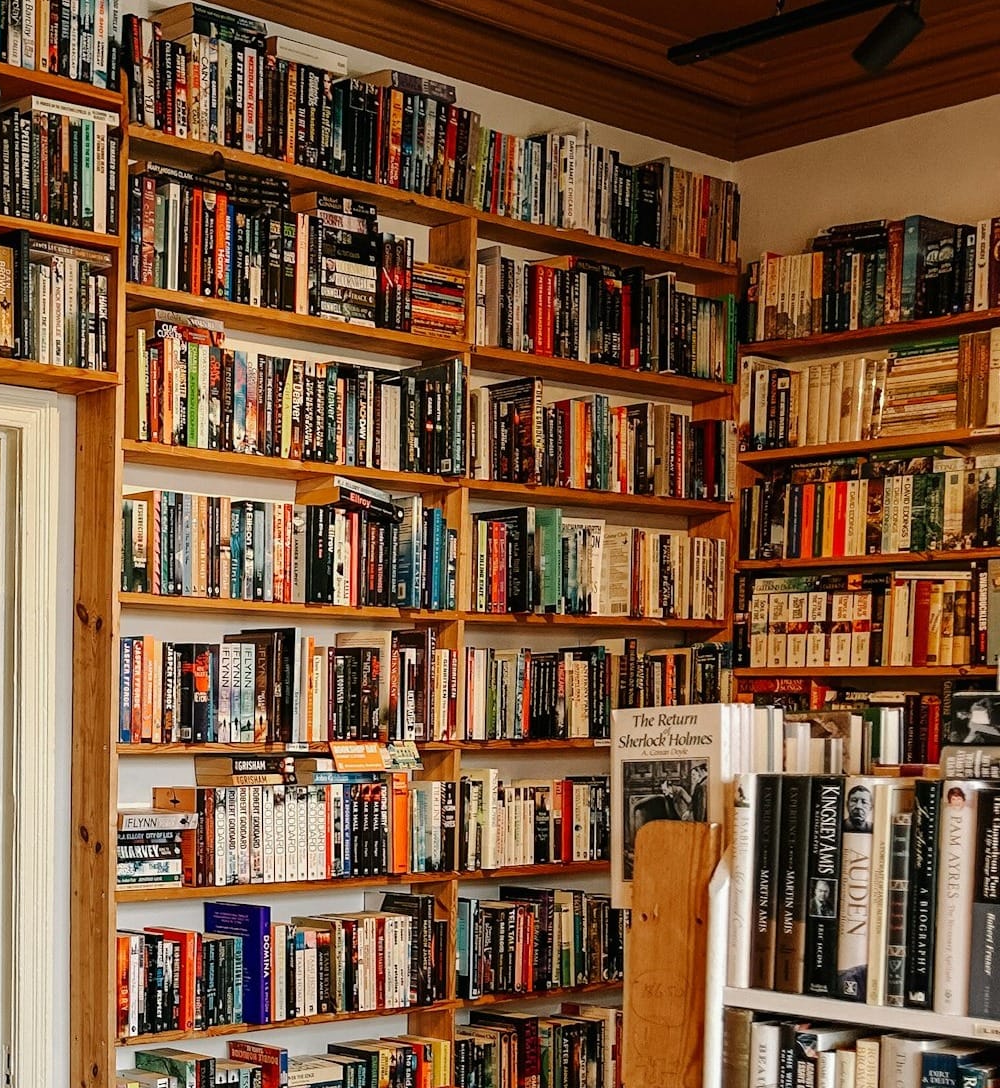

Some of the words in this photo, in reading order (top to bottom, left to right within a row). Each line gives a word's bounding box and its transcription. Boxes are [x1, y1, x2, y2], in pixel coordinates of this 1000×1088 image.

[246, 55, 255, 101] MEDDLING
[246, 102, 255, 125] KIDS
[567, 140, 575, 161] DAVID
[567, 161, 575, 186] MAMET
[567, 186, 575, 217] CHICAGO
[327, 384, 337, 421] Deaver
[349, 492, 372, 508] Ellroy
[979, 571, 988, 632] SWASHBUCKLERS
[165, 645, 174, 676] JASPER
[243, 650, 254, 689] FLYNN
[165, 678, 174, 710] FFORDE
[632, 713, 655, 728] The
[657, 713, 698, 727] Return
[662, 727, 672, 737] of
[618, 733, 667, 749] Sherlock
[668, 731, 713, 747] Holmes
[238, 760, 266, 772] GRISHAM
[240, 787, 248, 815] ROBERT
[252, 787, 261, 814] ROBERT
[820, 785, 840, 844] KINGSLEY
[240, 816, 248, 850] GODDARD
[252, 815, 261, 849] GODDARD
[812, 810, 820, 855] BIOGRAPHY
[948, 815, 962, 847] PAM
[817, 845, 836, 875] AMIS
[759, 869, 770, 907] MARTIN
[784, 869, 796, 909] MARTIN
[947, 852, 962, 900] AYRES
[848, 849, 869, 937] AUDEN
[758, 908, 769, 933] AMIS
[783, 910, 794, 934] AMIS
[817, 924, 825, 941] ERIC
[985, 912, 996, 943] Robert
[917, 900, 929, 975] BIOGRAPHY
[984, 944, 996, 977] Fraser
[785, 1048, 794, 1067] THIS
